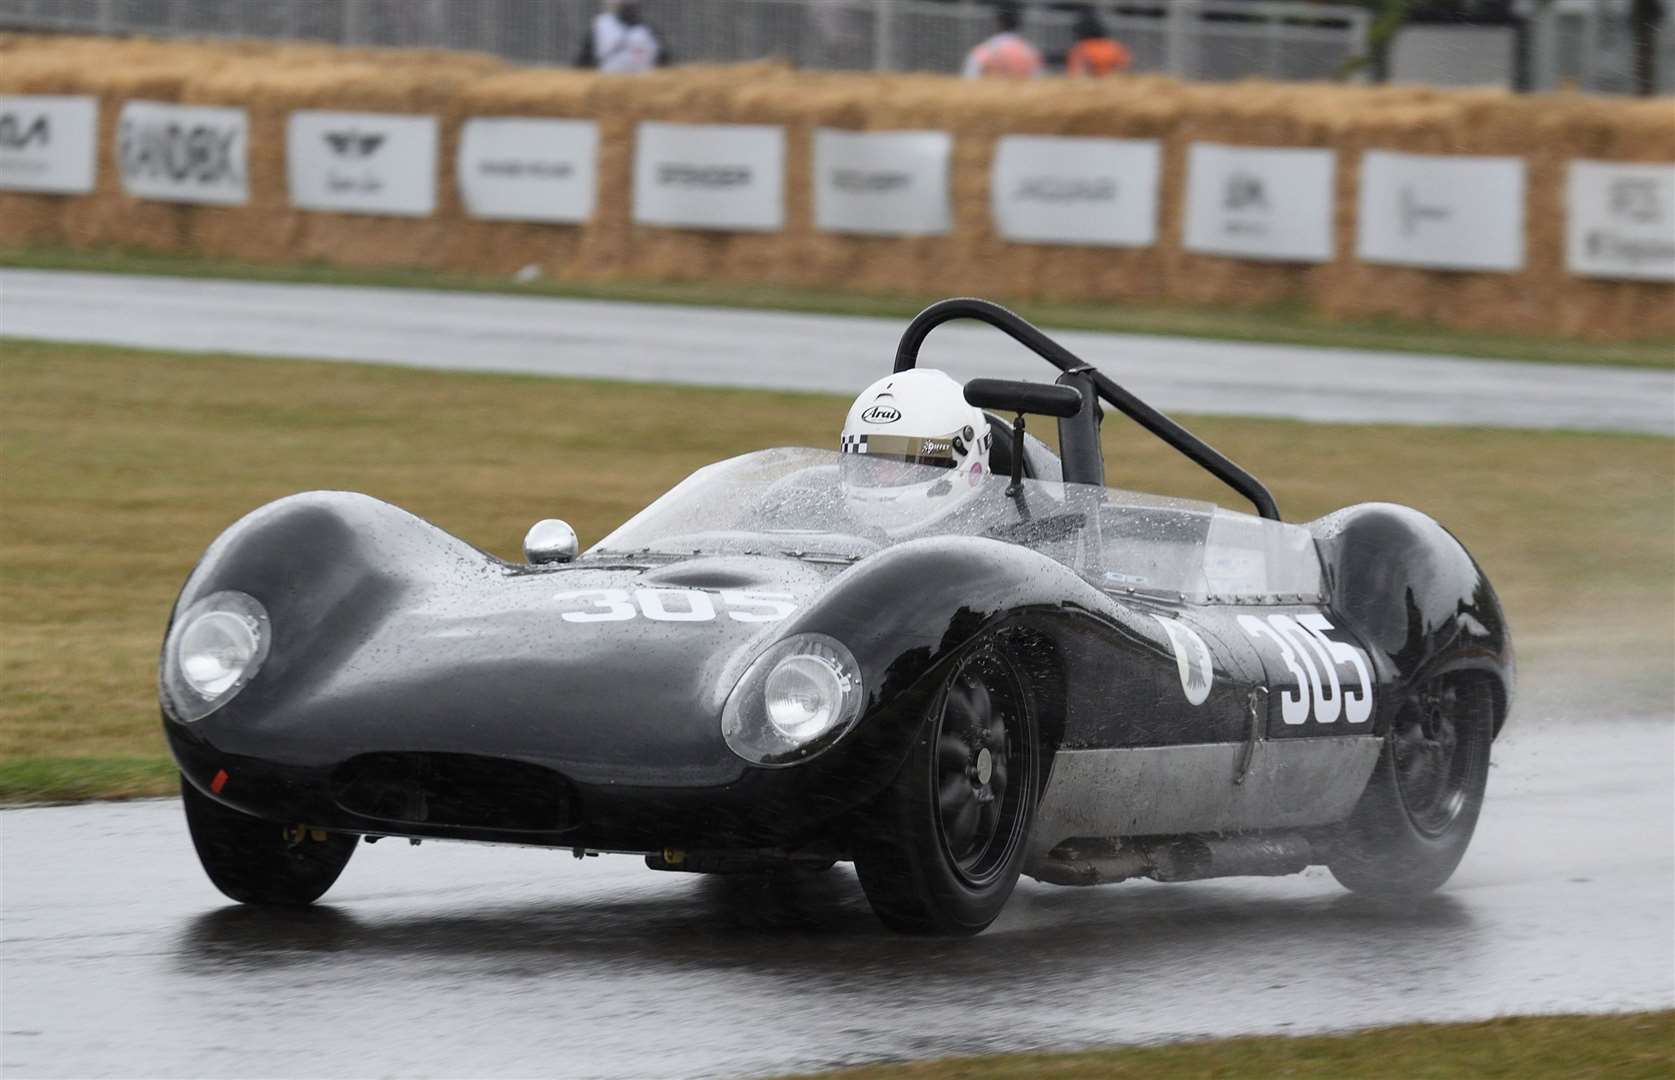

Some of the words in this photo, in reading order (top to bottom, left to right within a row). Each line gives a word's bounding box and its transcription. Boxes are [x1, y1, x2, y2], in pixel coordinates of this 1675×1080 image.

[863, 406, 897, 419] Arai
[552, 588, 798, 623] 305
[1236, 613, 1373, 725] 305
